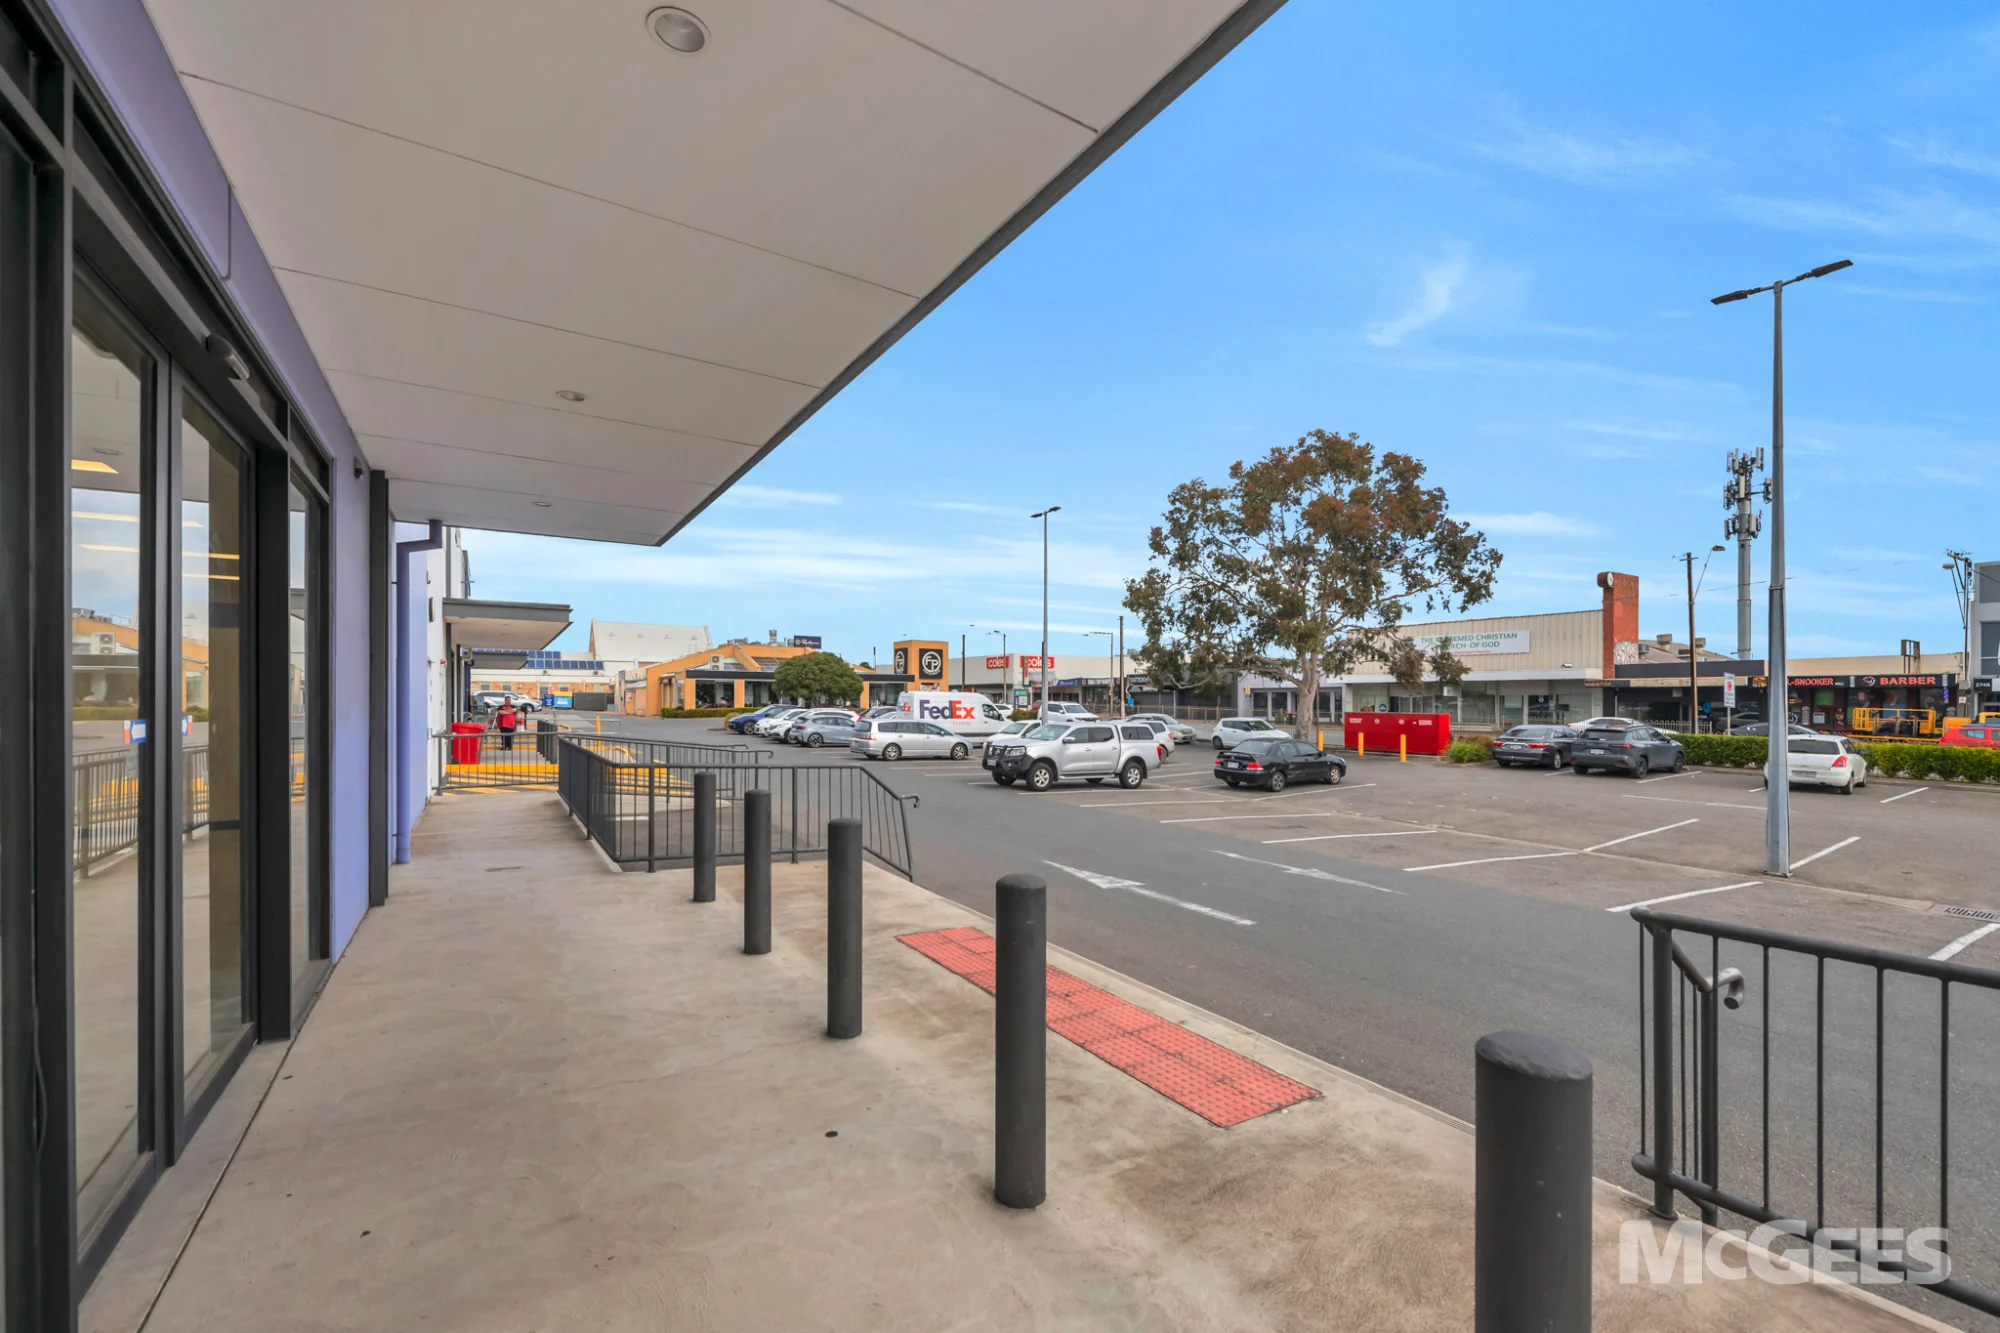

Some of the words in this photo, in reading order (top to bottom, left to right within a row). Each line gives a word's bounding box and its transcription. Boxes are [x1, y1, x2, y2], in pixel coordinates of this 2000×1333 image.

[1436, 635, 1474, 643] REMED
[1476, 632, 1518, 640] CHRISTIAN
[988, 656, 1005, 668] coles
[1880, 676, 1936, 685] BARBER
[919, 699, 976, 720] FedEx
